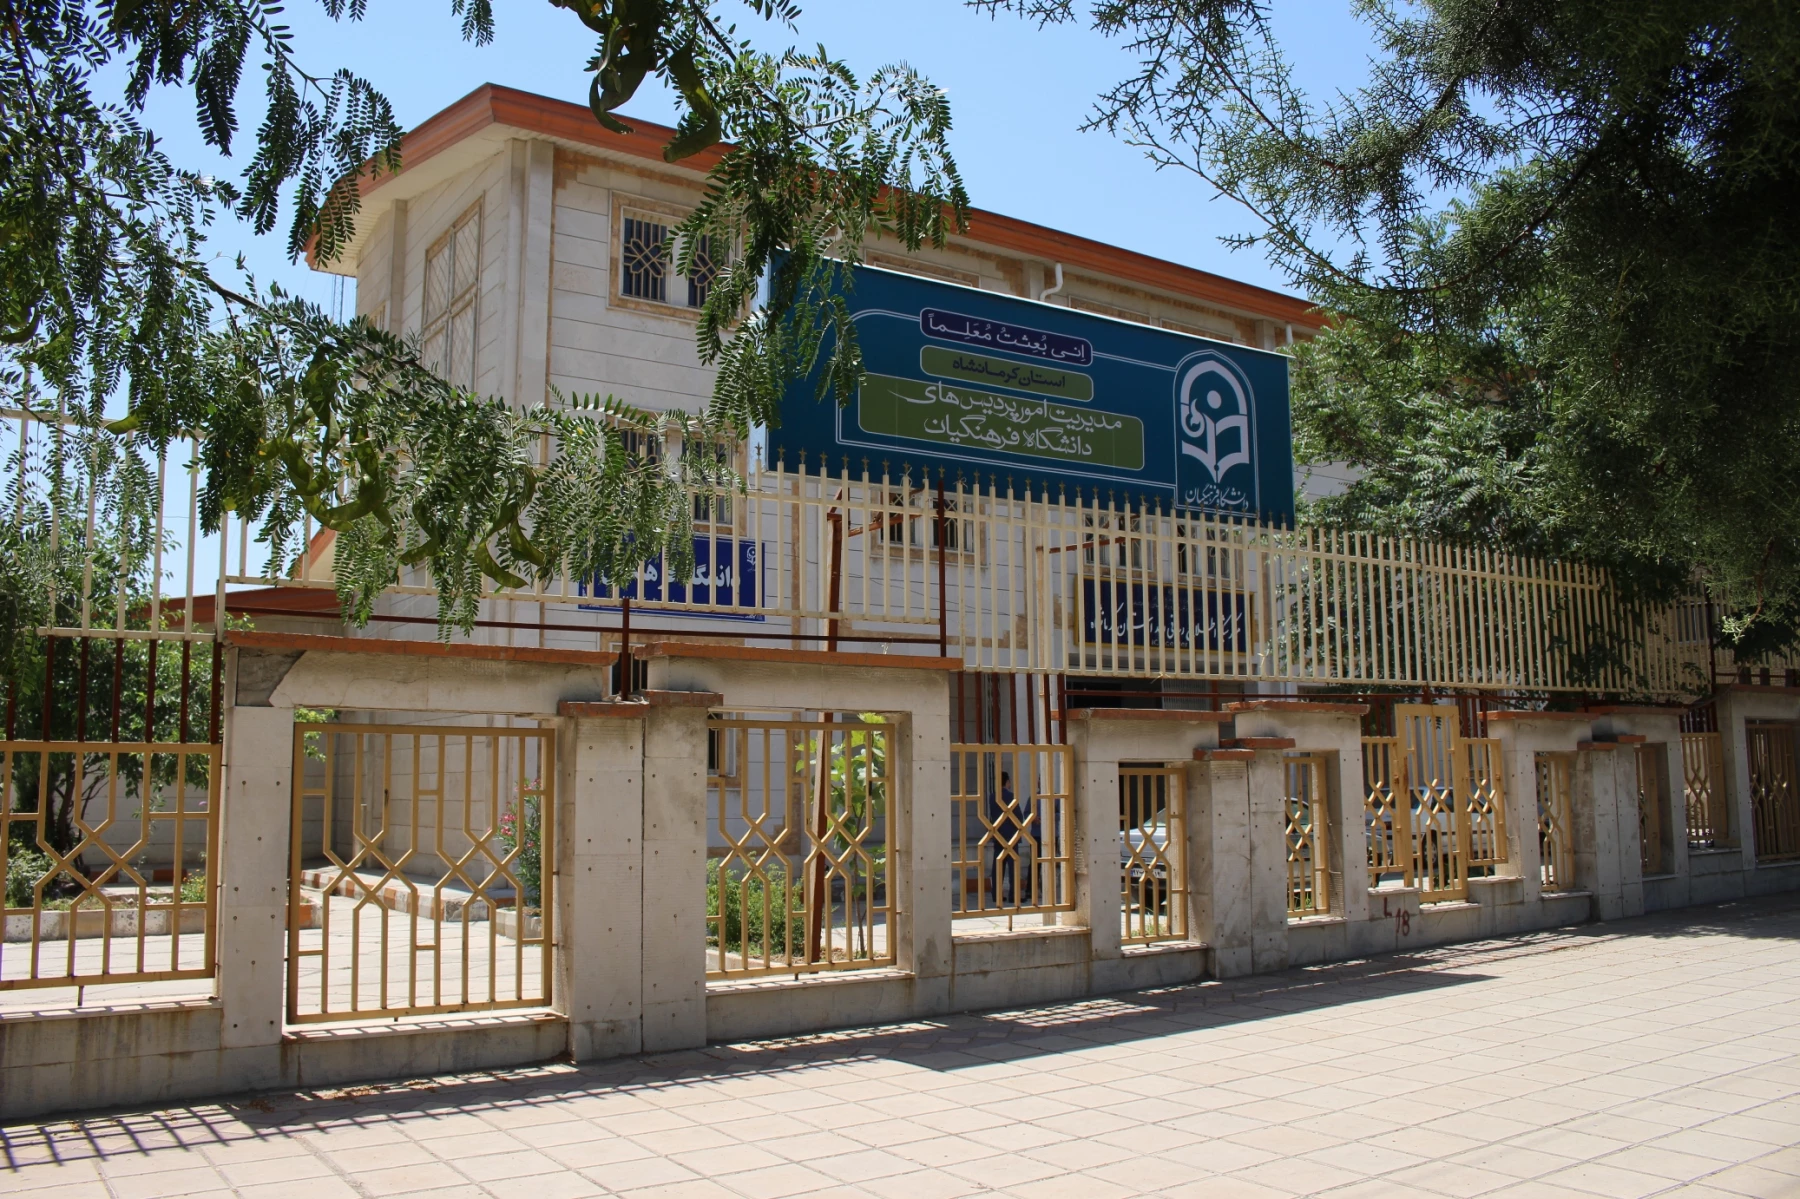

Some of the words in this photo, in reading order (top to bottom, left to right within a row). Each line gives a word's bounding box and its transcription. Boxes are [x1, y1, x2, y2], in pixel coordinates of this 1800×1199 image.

[953, 356, 1020, 383] کرمانشاه
[1018, 370, 1065, 388] استان
[1012, 398, 1048, 424] امور
[1049, 409, 1122, 432] مدیریت
[924, 415, 1020, 449] فرهنگیان
[1023, 427, 1092, 456] دانشگاه
